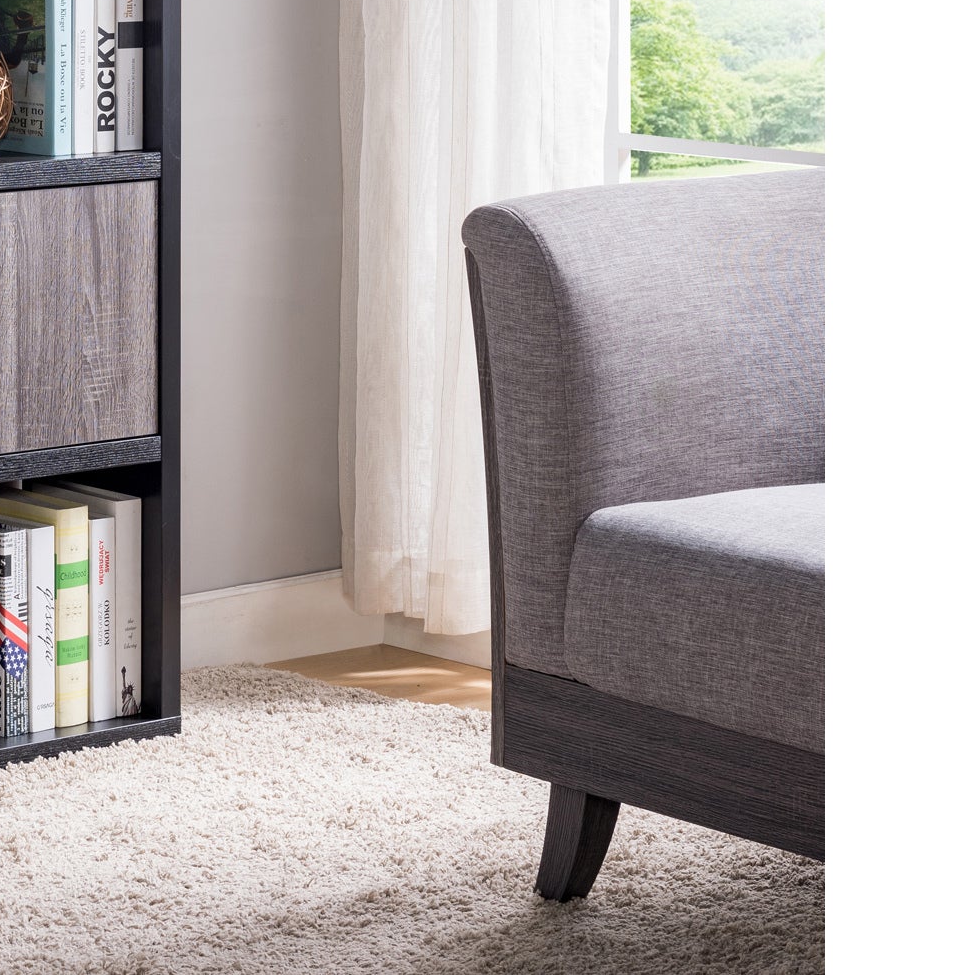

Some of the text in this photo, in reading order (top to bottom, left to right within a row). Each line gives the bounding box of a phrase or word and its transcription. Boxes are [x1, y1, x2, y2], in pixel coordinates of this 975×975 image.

[60, 44, 66, 55] La
[97, 26, 115, 132] ROCKY
[61, 92, 66, 102] ou
[20, 107, 29, 116] la
[31, 108, 44, 116] ou
[10, 117, 44, 130] La Box
[60, 569, 87, 581] Childhood
